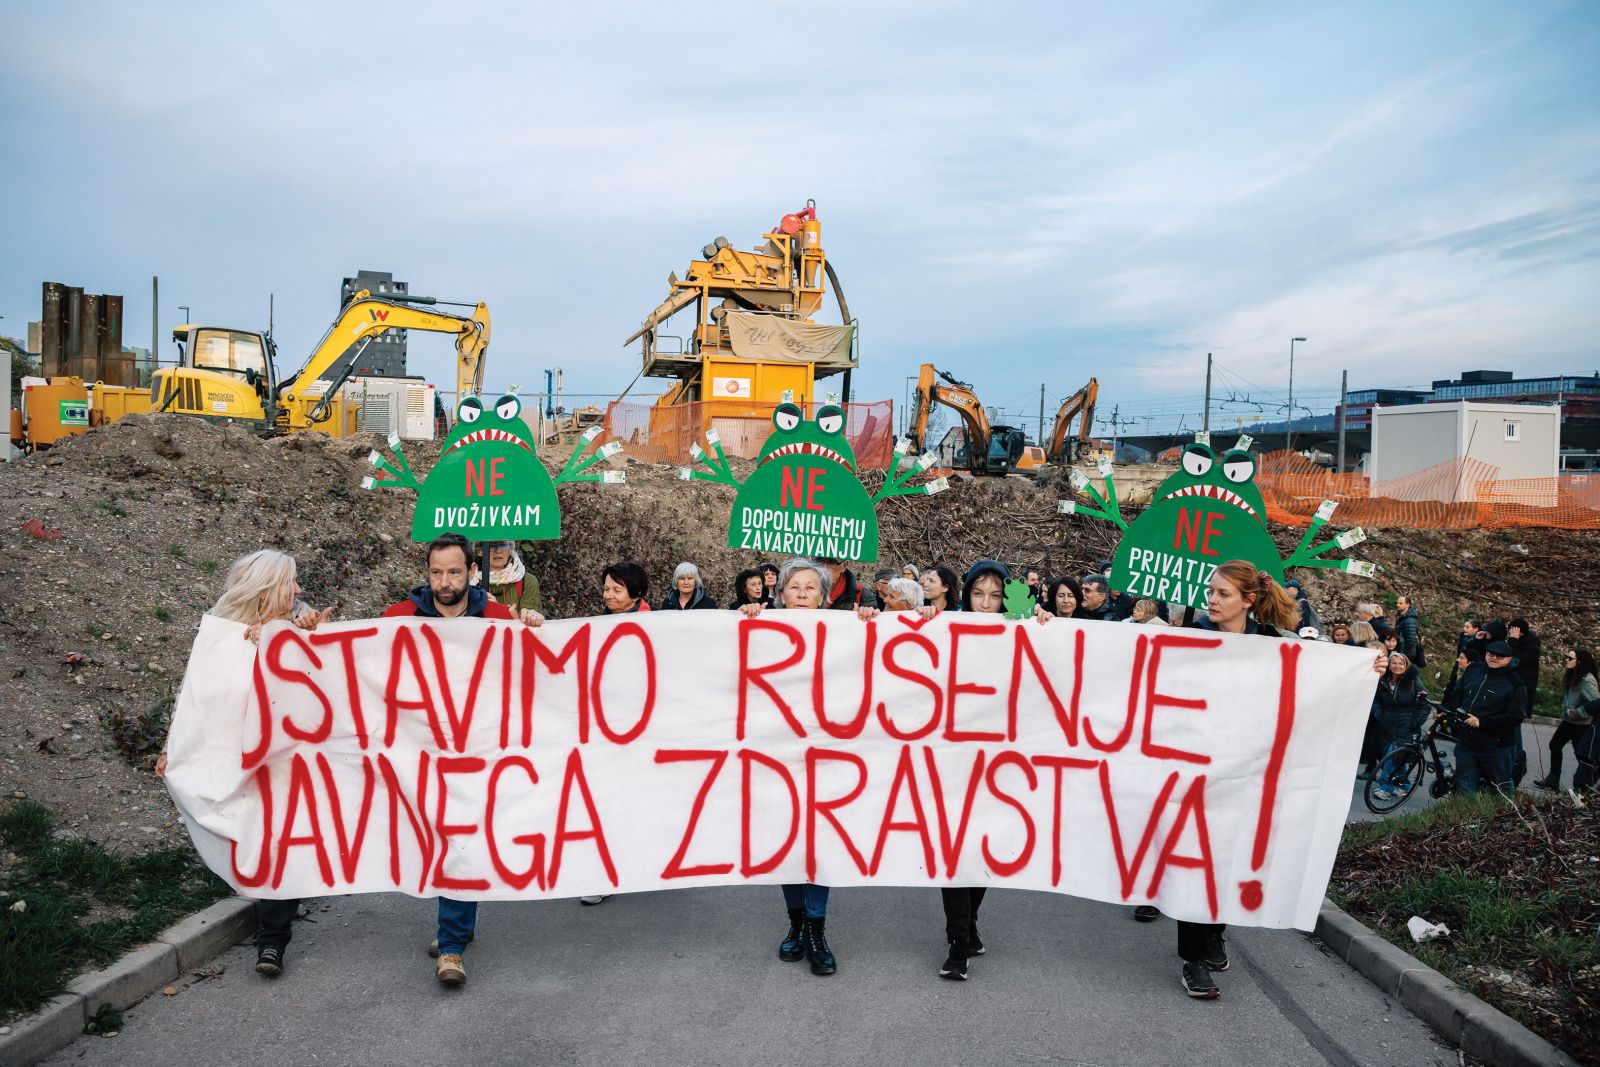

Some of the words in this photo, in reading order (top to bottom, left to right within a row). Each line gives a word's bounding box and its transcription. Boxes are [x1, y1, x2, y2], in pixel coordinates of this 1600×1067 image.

[948, 391, 967, 405] CASE
[466, 457, 505, 497] NE
[780, 465, 827, 511] NE
[434, 502, 541, 528] DVOŽIVKAM
[742, 507, 866, 540] DOPOLNILNEMU
[1173, 507, 1226, 557] NE
[740, 528, 862, 561] ZAVAROVANJU
[736, 609, 1223, 766] RUŠENJE
[228, 746, 620, 894] JAVNEGA
